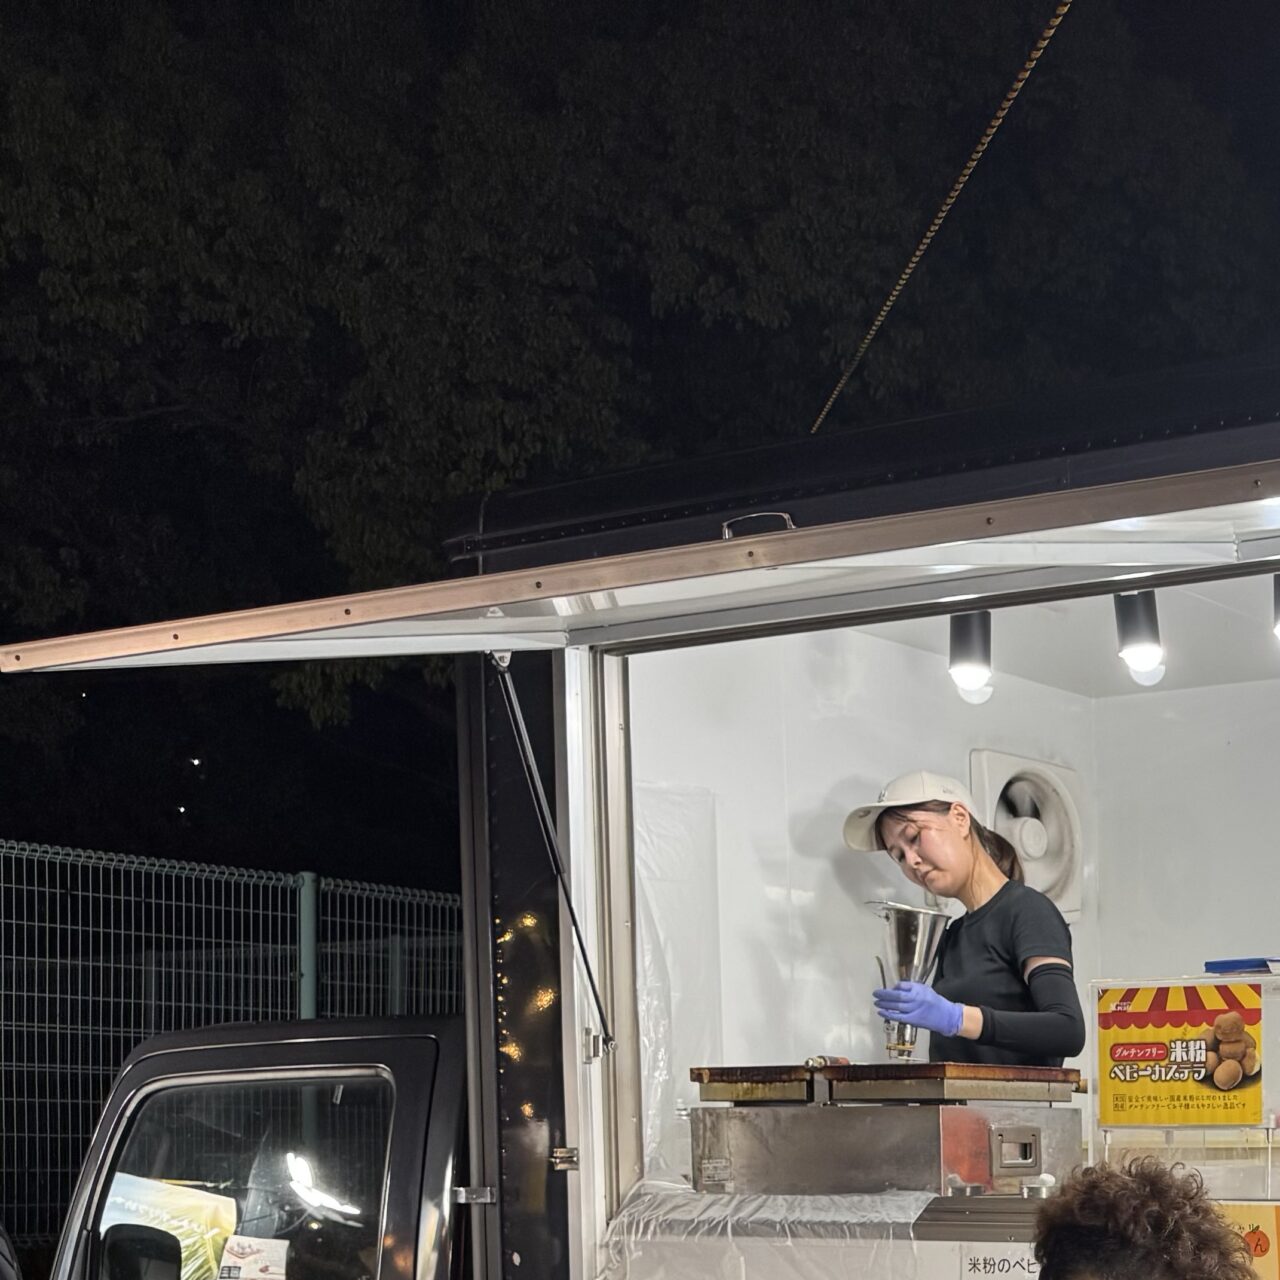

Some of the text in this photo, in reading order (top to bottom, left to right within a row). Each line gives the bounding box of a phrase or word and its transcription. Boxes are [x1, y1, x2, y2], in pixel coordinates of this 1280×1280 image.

[1114, 1039, 1207, 1063] グルテンフリー 米粉
[1110, 1064, 1207, 1082] ベビーカステラ
